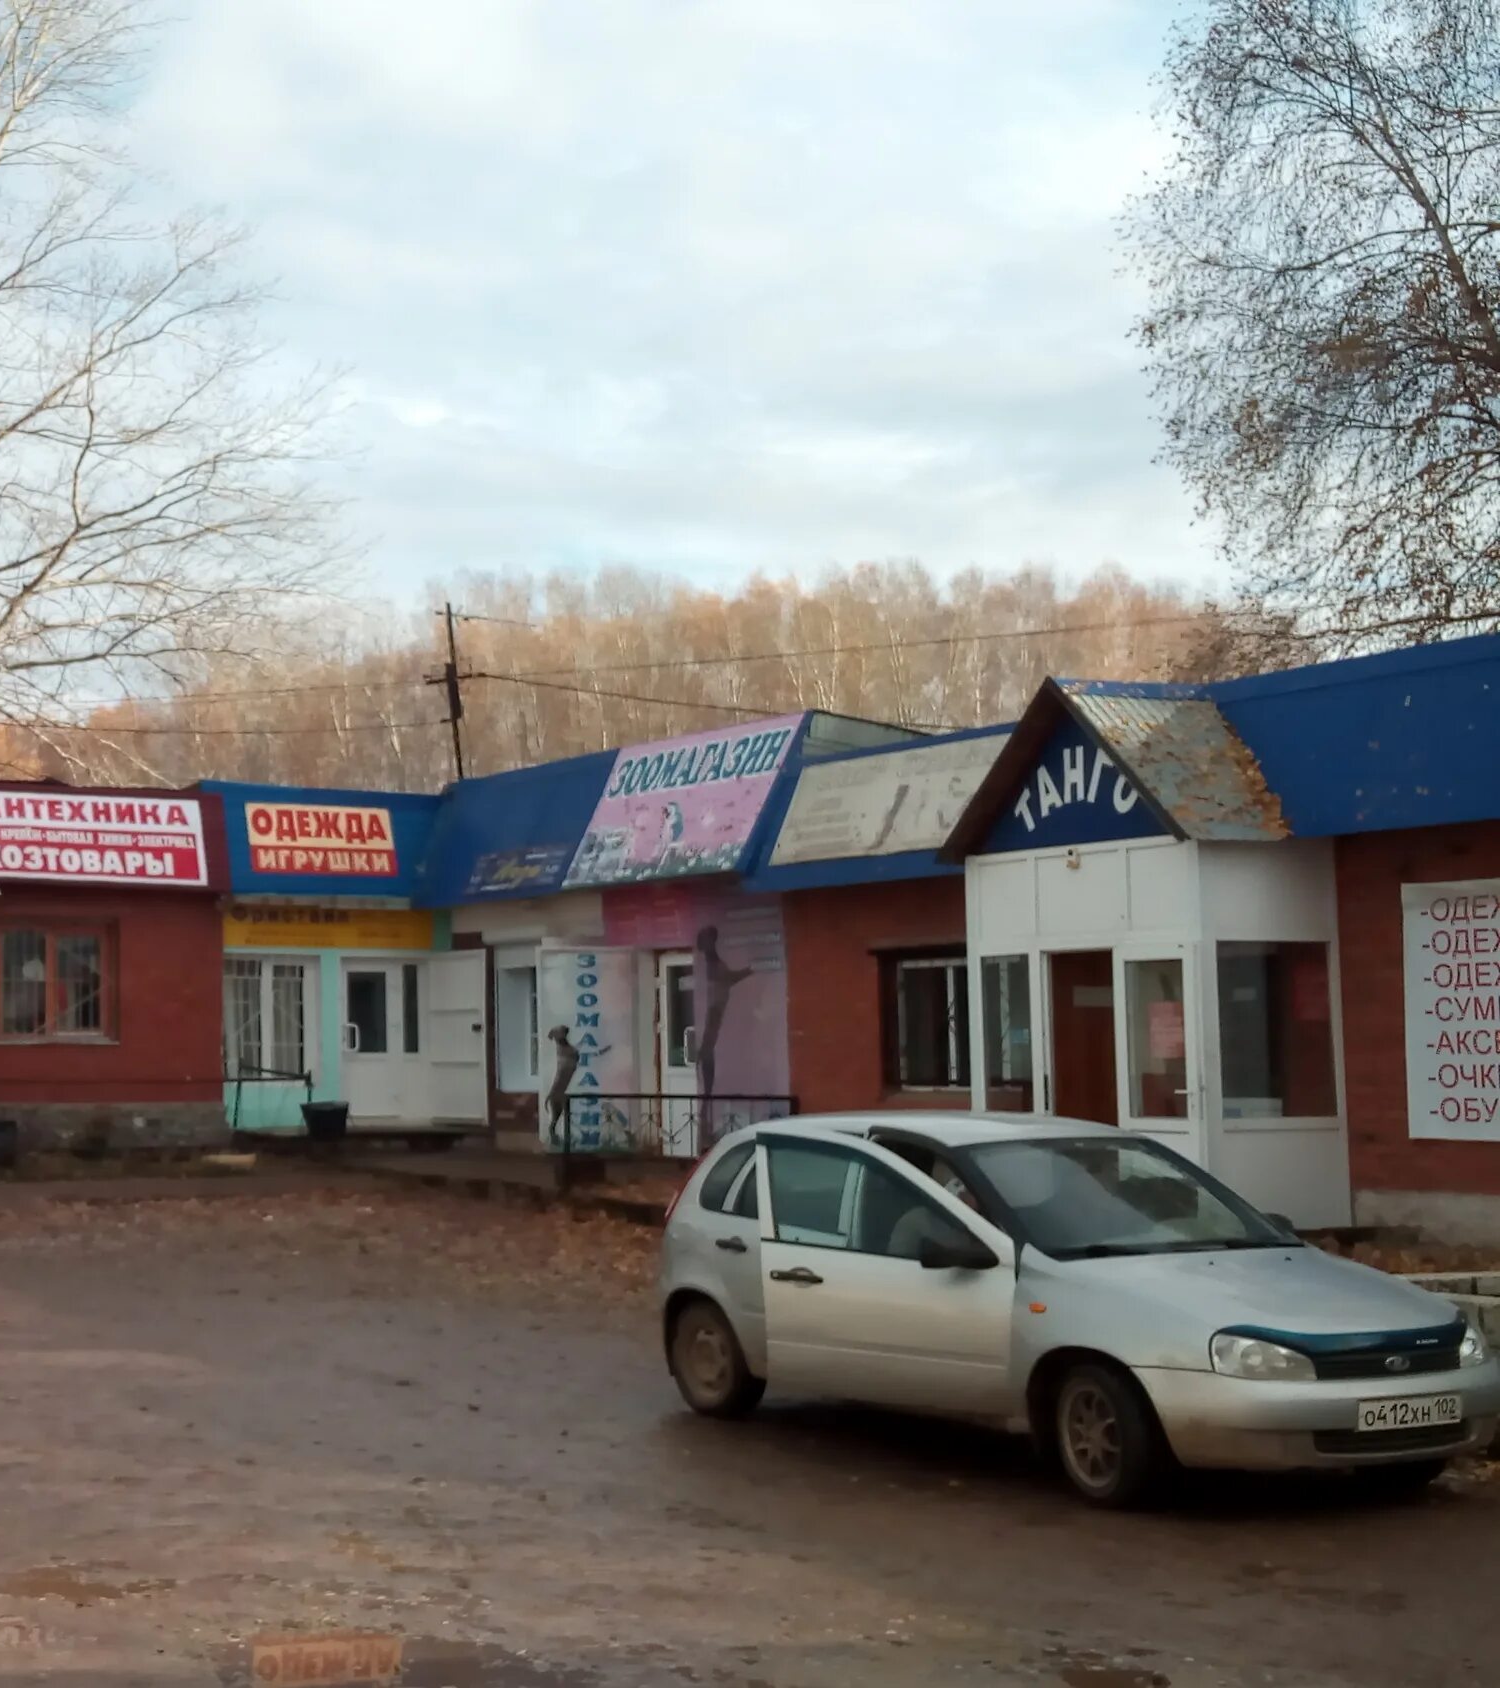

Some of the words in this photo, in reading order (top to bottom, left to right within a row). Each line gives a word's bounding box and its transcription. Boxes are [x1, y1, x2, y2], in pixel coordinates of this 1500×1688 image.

[608, 727, 791, 799] ЗООМАГАЗИН
[251, 808, 387, 844] ОДЕЖДА
[256, 848, 390, 873] ИГРУШКИ
[1425, 995, 1500, 1022] -СУМ
[1428, 1063, 1500, 1089] -ОЧК
